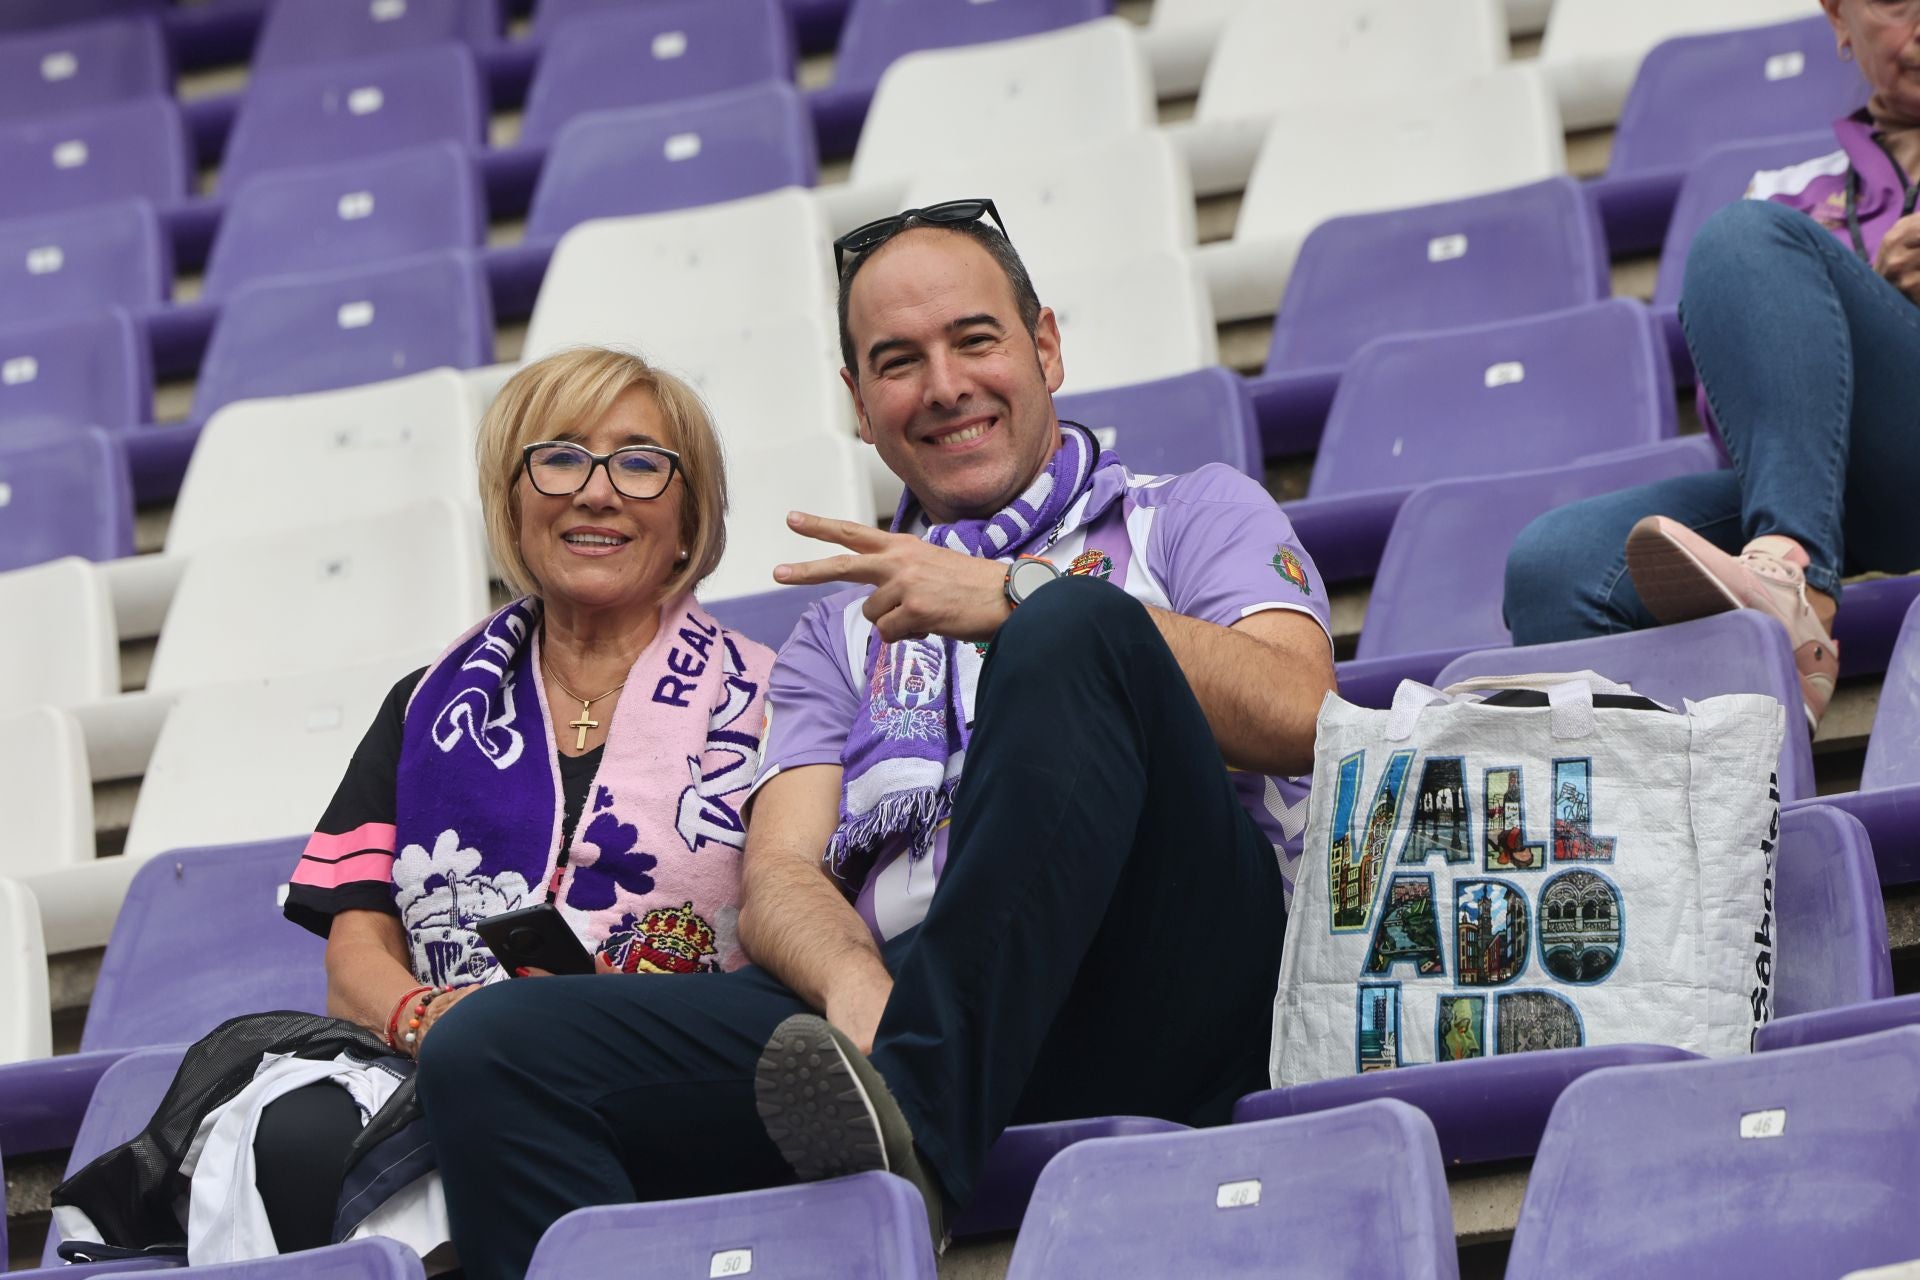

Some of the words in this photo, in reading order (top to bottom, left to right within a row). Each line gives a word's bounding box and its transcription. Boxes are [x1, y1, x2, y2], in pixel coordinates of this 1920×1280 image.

[652, 612, 718, 708] REAL
[1329, 748, 1618, 936] VALL
[1359, 865, 1627, 988] ADO
[1354, 979, 1586, 1075] LID
[1753, 1117, 1772, 1134] 46
[722, 1256, 742, 1273] 50
